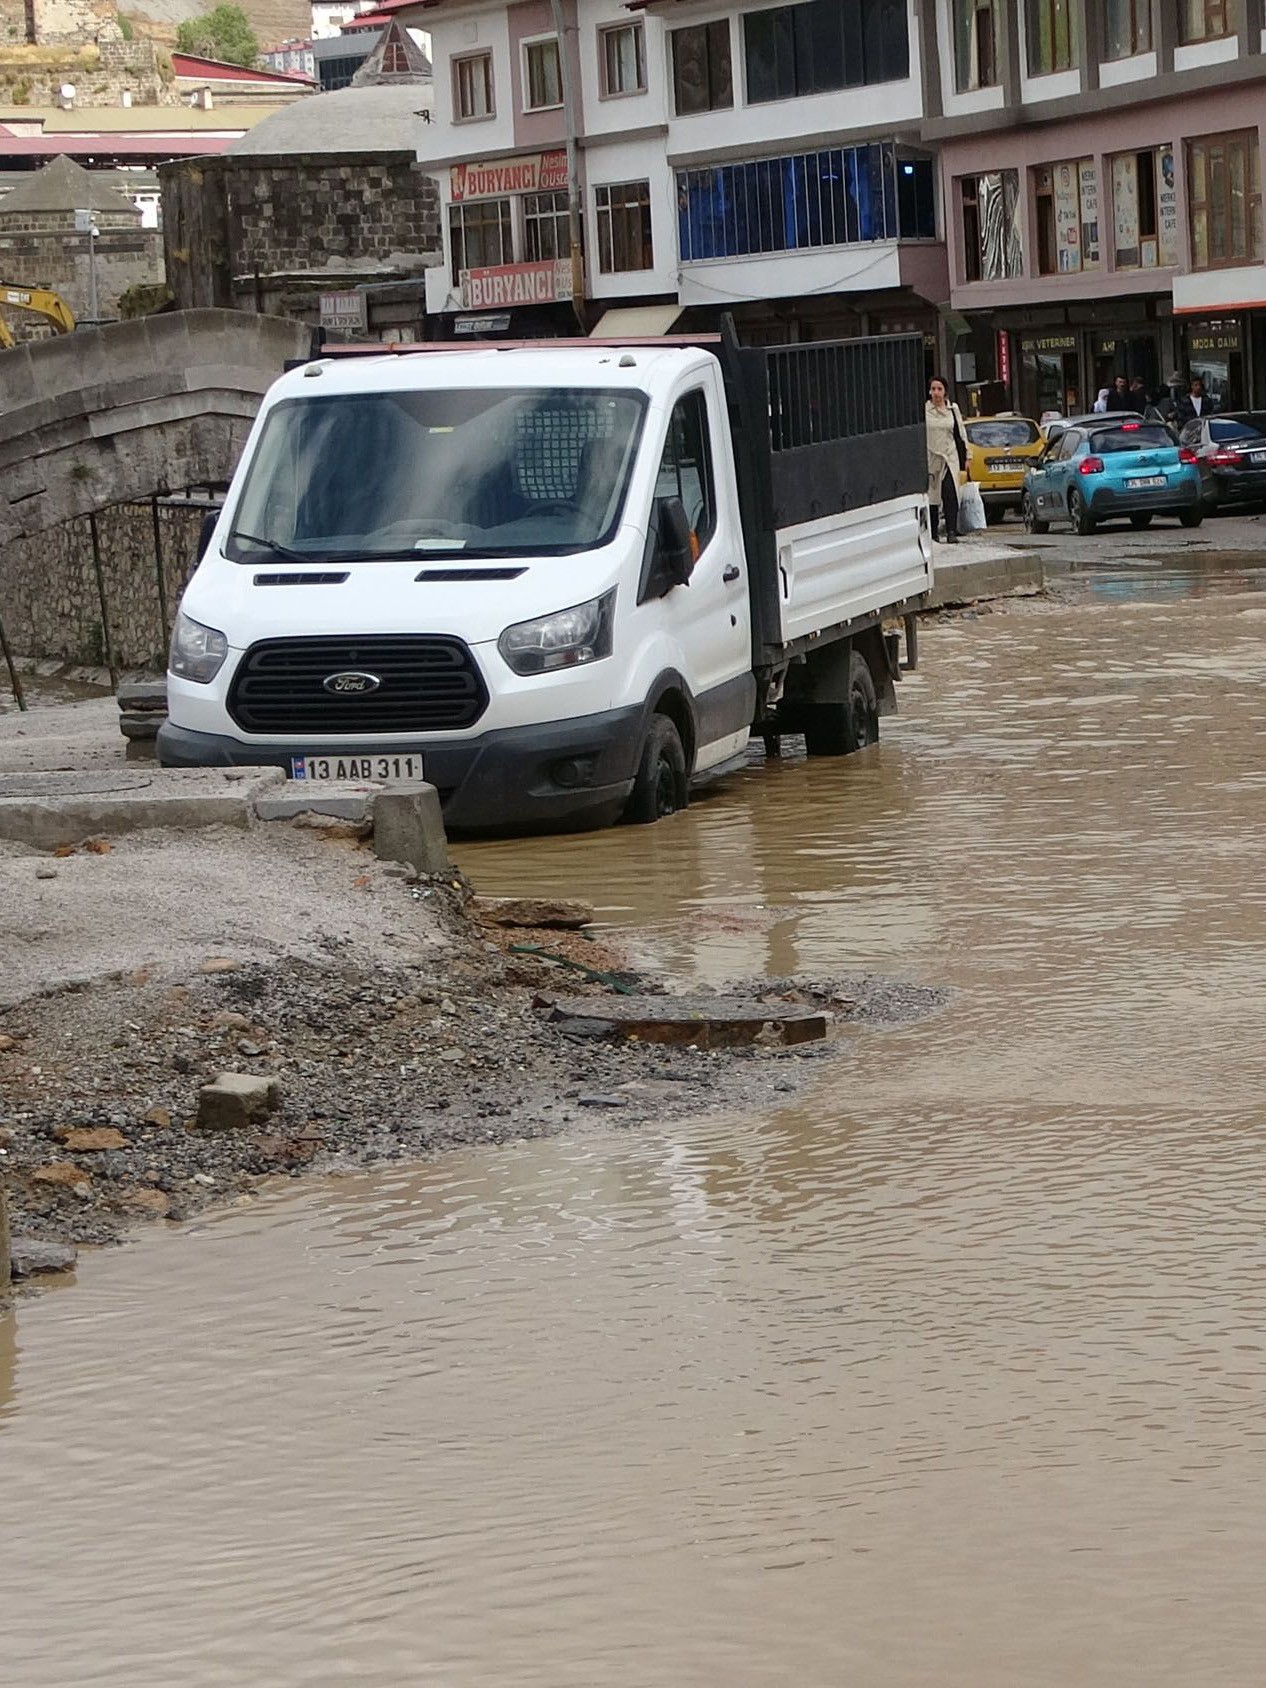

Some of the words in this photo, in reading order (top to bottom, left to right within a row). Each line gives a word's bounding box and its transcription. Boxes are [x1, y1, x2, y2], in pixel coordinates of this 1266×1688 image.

[472, 270, 554, 306] BÜRYANCI
[335, 676, 366, 690] Ford
[309, 759, 330, 779] 13
[337, 759, 372, 779] AAB
[378, 758, 413, 779] 311
